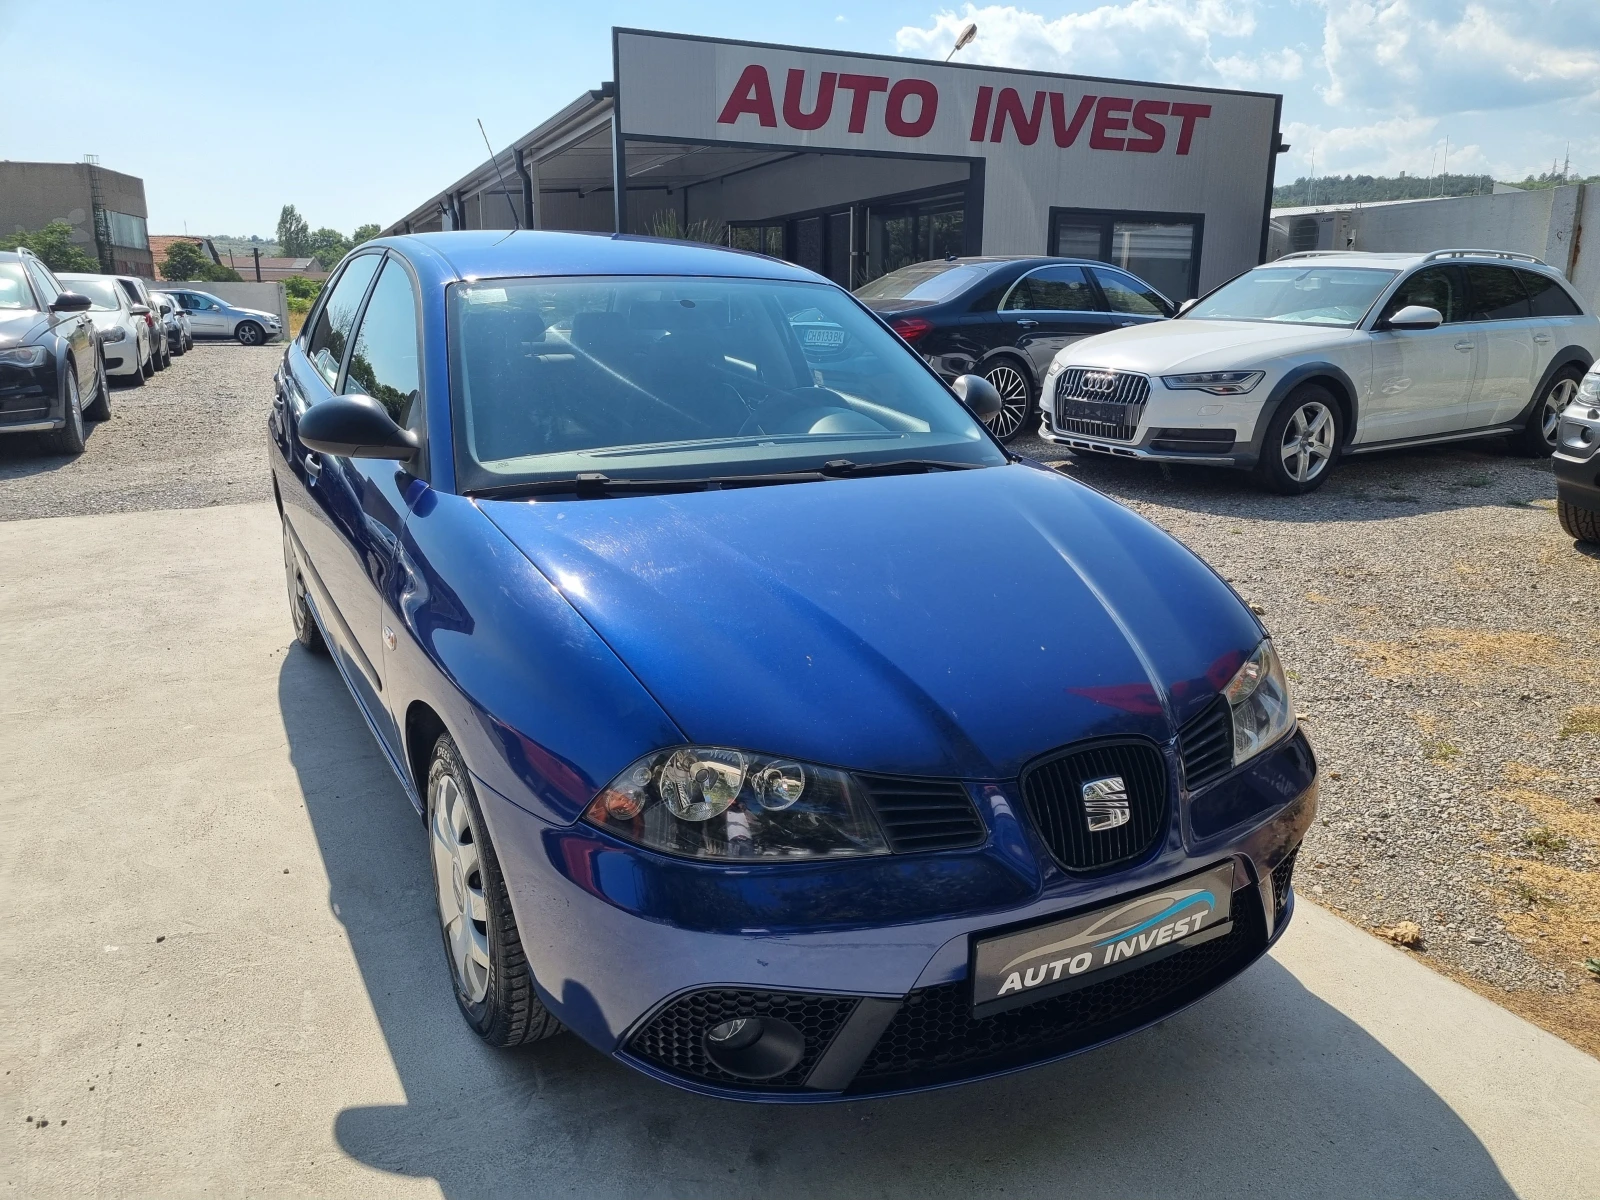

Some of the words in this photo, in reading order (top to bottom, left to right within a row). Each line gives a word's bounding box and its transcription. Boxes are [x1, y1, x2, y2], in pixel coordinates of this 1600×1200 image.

[717, 64, 938, 138] AUTO
[969, 85, 1212, 156] INVEST
[997, 952, 1093, 996] AUTO
[1103, 909, 1209, 965] INVEST
